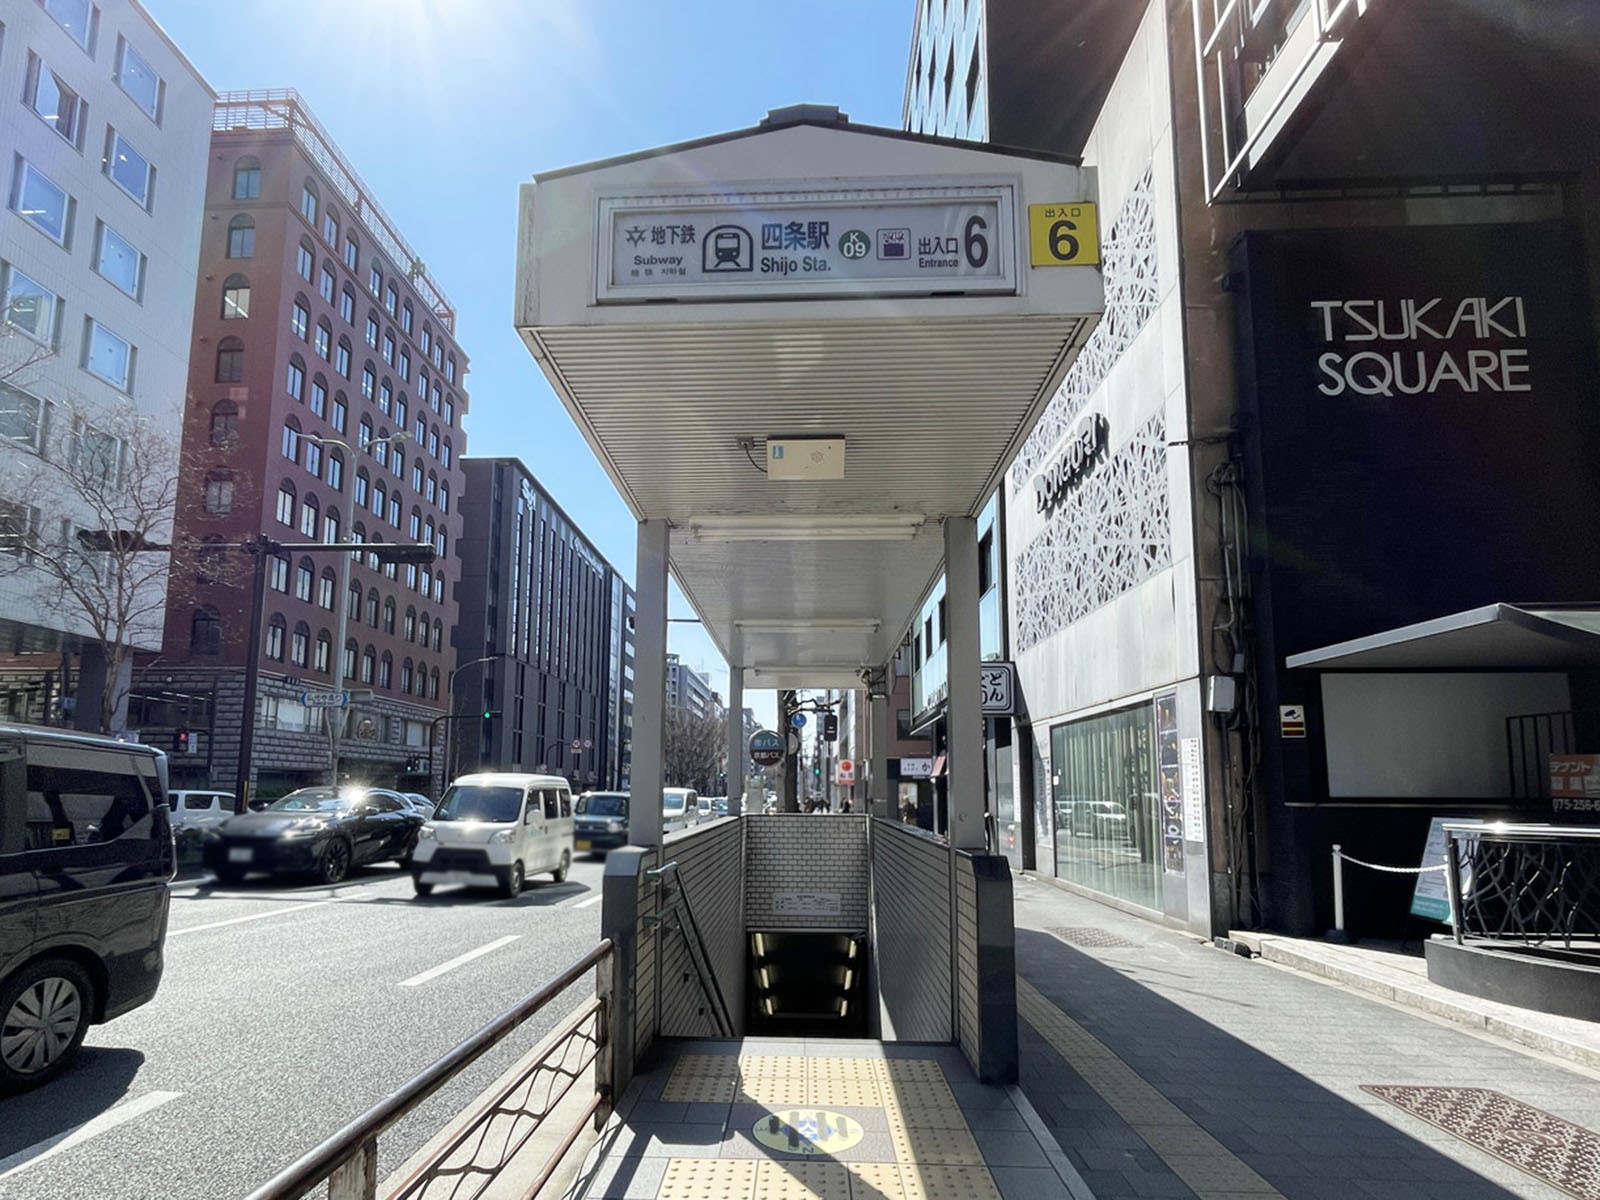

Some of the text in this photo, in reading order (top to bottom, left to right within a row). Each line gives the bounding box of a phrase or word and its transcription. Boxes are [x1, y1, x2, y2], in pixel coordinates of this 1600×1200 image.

[1045, 208, 1081, 217] 出入口
[651, 225, 696, 245] 地下鉄
[761, 221, 830, 250] 四条駅
[850, 232, 859, 242] K
[964, 215, 989, 269] 6
[1048, 220, 1080, 261] 6
[843, 242, 866, 257] 09
[918, 237, 958, 255] 出入口
[634, 255, 683, 266] Subway
[760, 256, 831, 275] Shijo Sta.
[918, 258, 958, 268] Entrance
[1310, 297, 1526, 341] TSUKAKI
[1317, 349, 1532, 397] SQUARE
